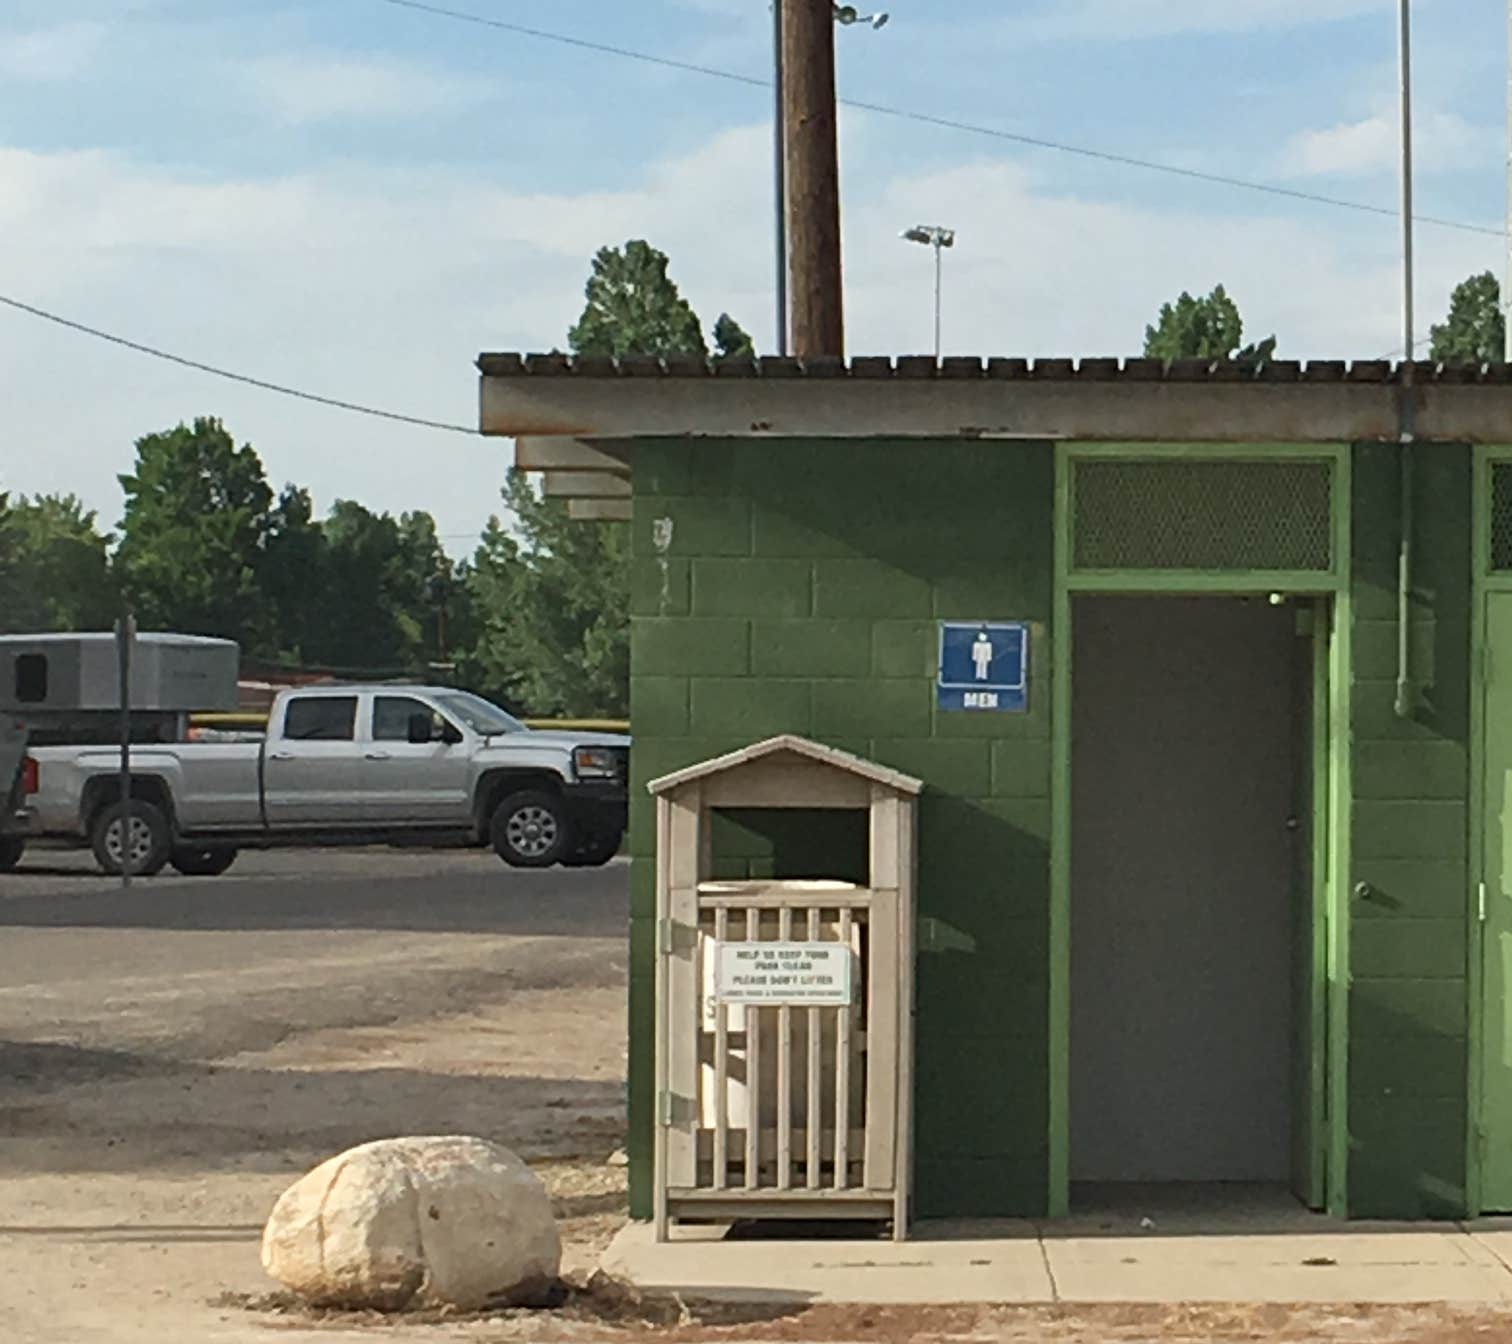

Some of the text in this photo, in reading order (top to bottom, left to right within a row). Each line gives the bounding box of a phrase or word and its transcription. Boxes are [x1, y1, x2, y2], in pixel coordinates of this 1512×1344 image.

[963, 692, 999, 708] MEN
[736, 951, 761, 959] HELP
[732, 975, 767, 985] PLEASE
[800, 975, 833, 985] LITTER
